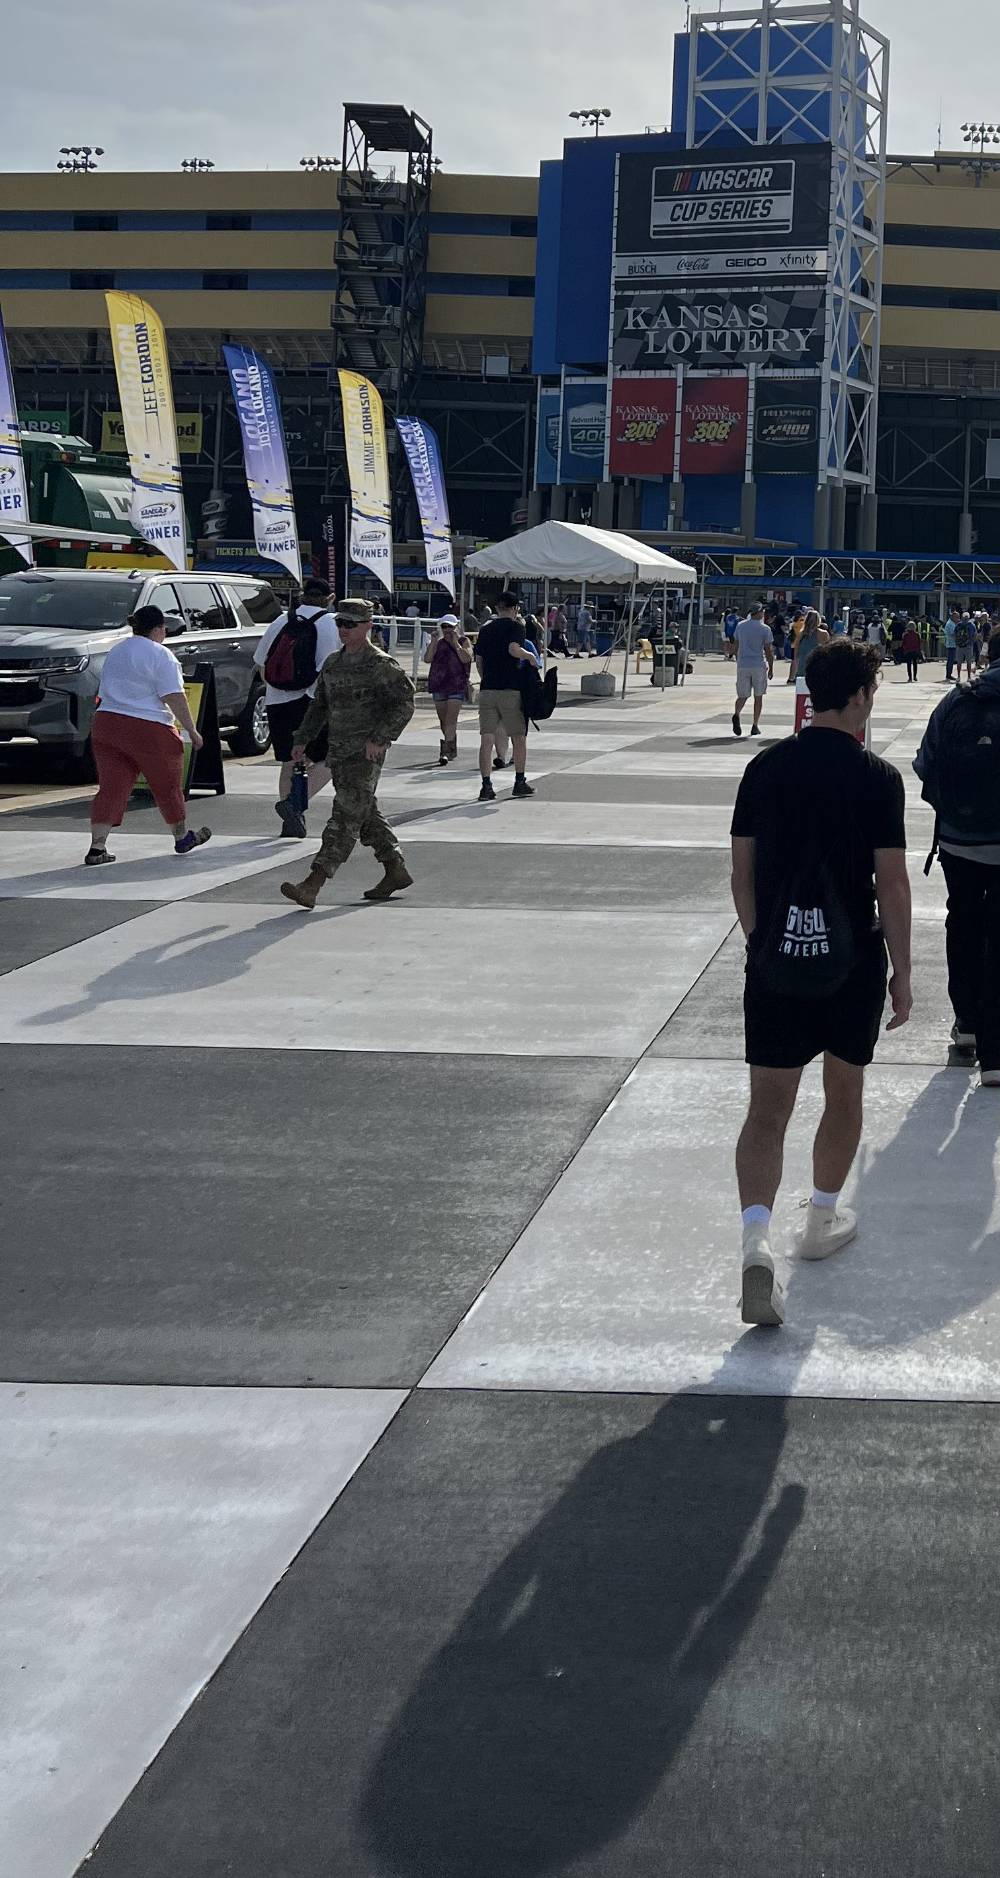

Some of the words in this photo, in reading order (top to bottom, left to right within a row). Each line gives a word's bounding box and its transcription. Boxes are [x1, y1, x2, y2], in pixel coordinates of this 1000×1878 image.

[696, 167, 774, 191] NASCAR
[669, 202, 707, 222] CUP
[708, 199, 774, 220] SERIES
[627, 264, 657, 275] BUSCH
[725, 257, 767, 268] GEICO
[779, 252, 818, 268] xfinity
[624, 304, 769, 330] KANSAS
[644, 327, 818, 354] LOTTERY
[134, 322, 154, 384] GORDON
[143, 387, 158, 417] JEFF
[247, 366, 266, 418] LOGANO
[231, 368, 262, 451] LOGANO
[360, 384, 373, 437] JOHNSON
[616, 405, 658, 414] KANSAS
[621, 412, 670, 421] LOTTERY
[685, 404, 730, 413] KANSAS
[691, 411, 743, 421] LOTTERY
[257, 419, 272, 448] JOEY
[624, 421, 657, 439] 200
[694, 421, 731, 439] 300
[363, 441, 375, 474] JIMMIE
[352, 546, 389, 558] WINNER
